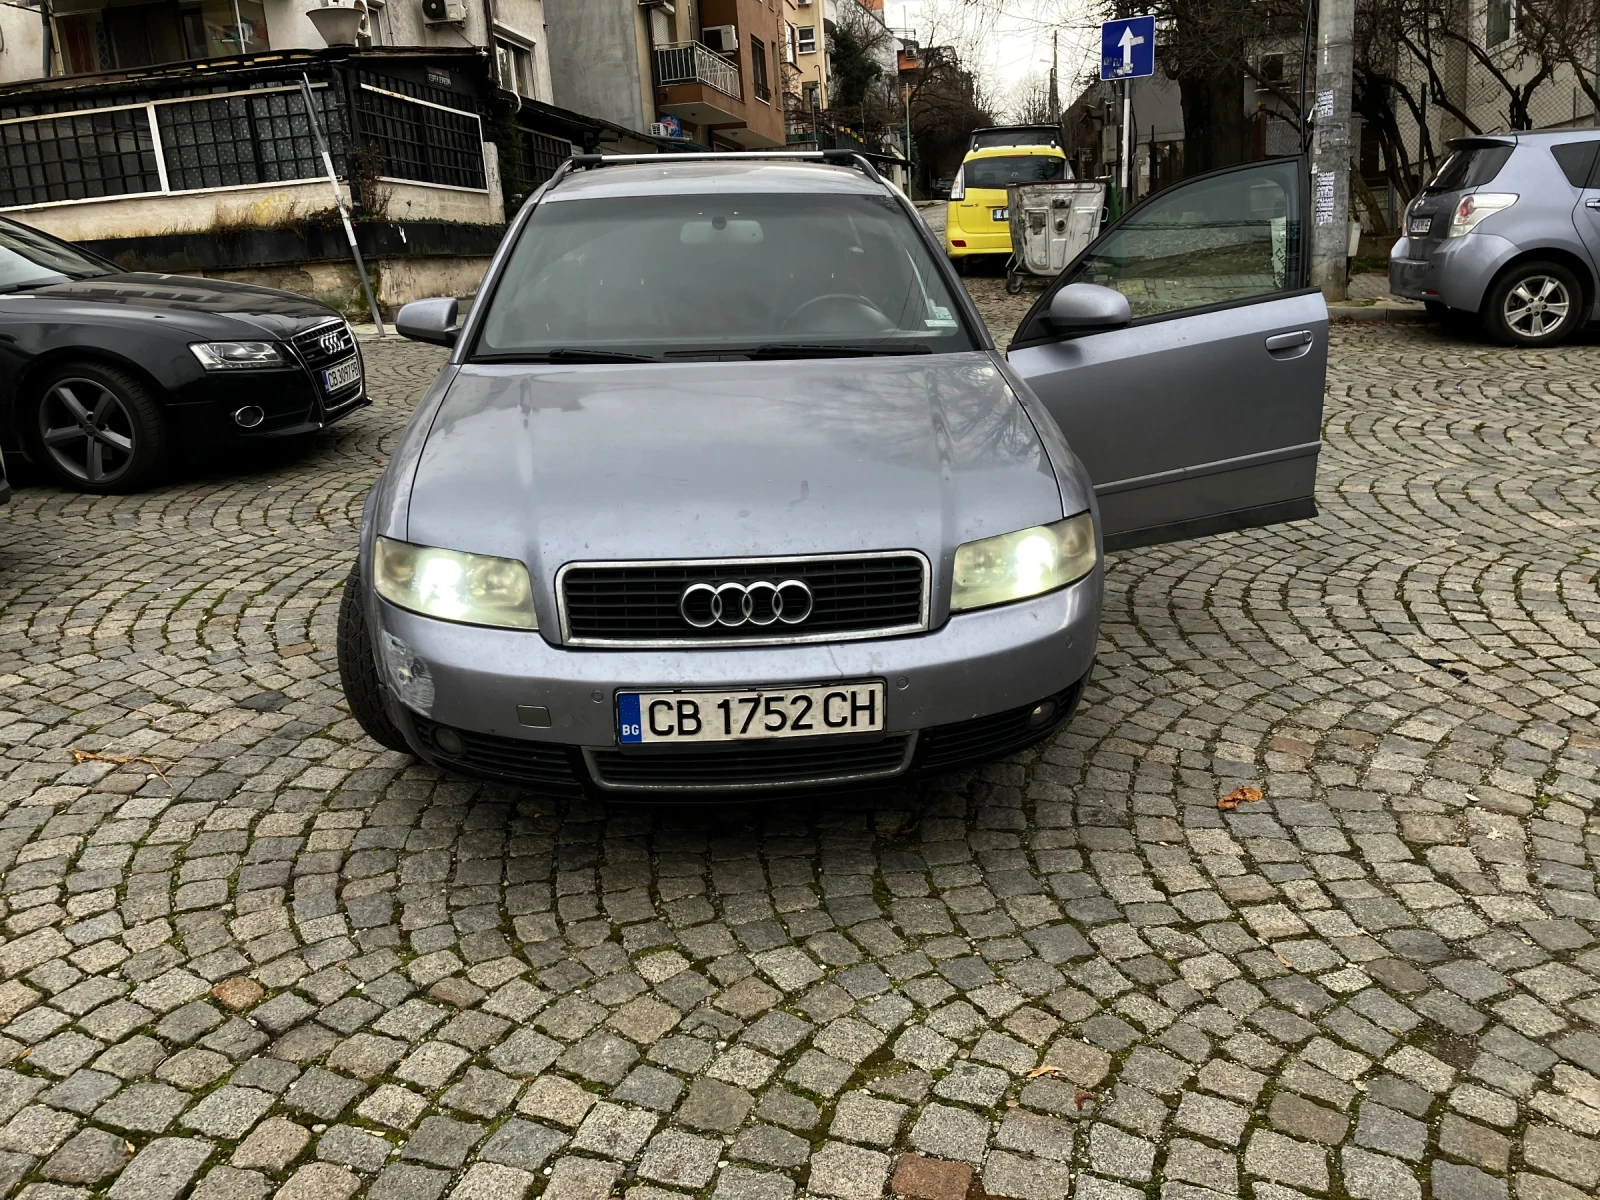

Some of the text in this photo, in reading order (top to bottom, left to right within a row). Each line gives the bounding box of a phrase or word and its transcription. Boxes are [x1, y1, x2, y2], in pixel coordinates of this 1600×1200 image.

[648, 689, 876, 736] CB 1752 CH
[622, 724, 639, 736] BG
